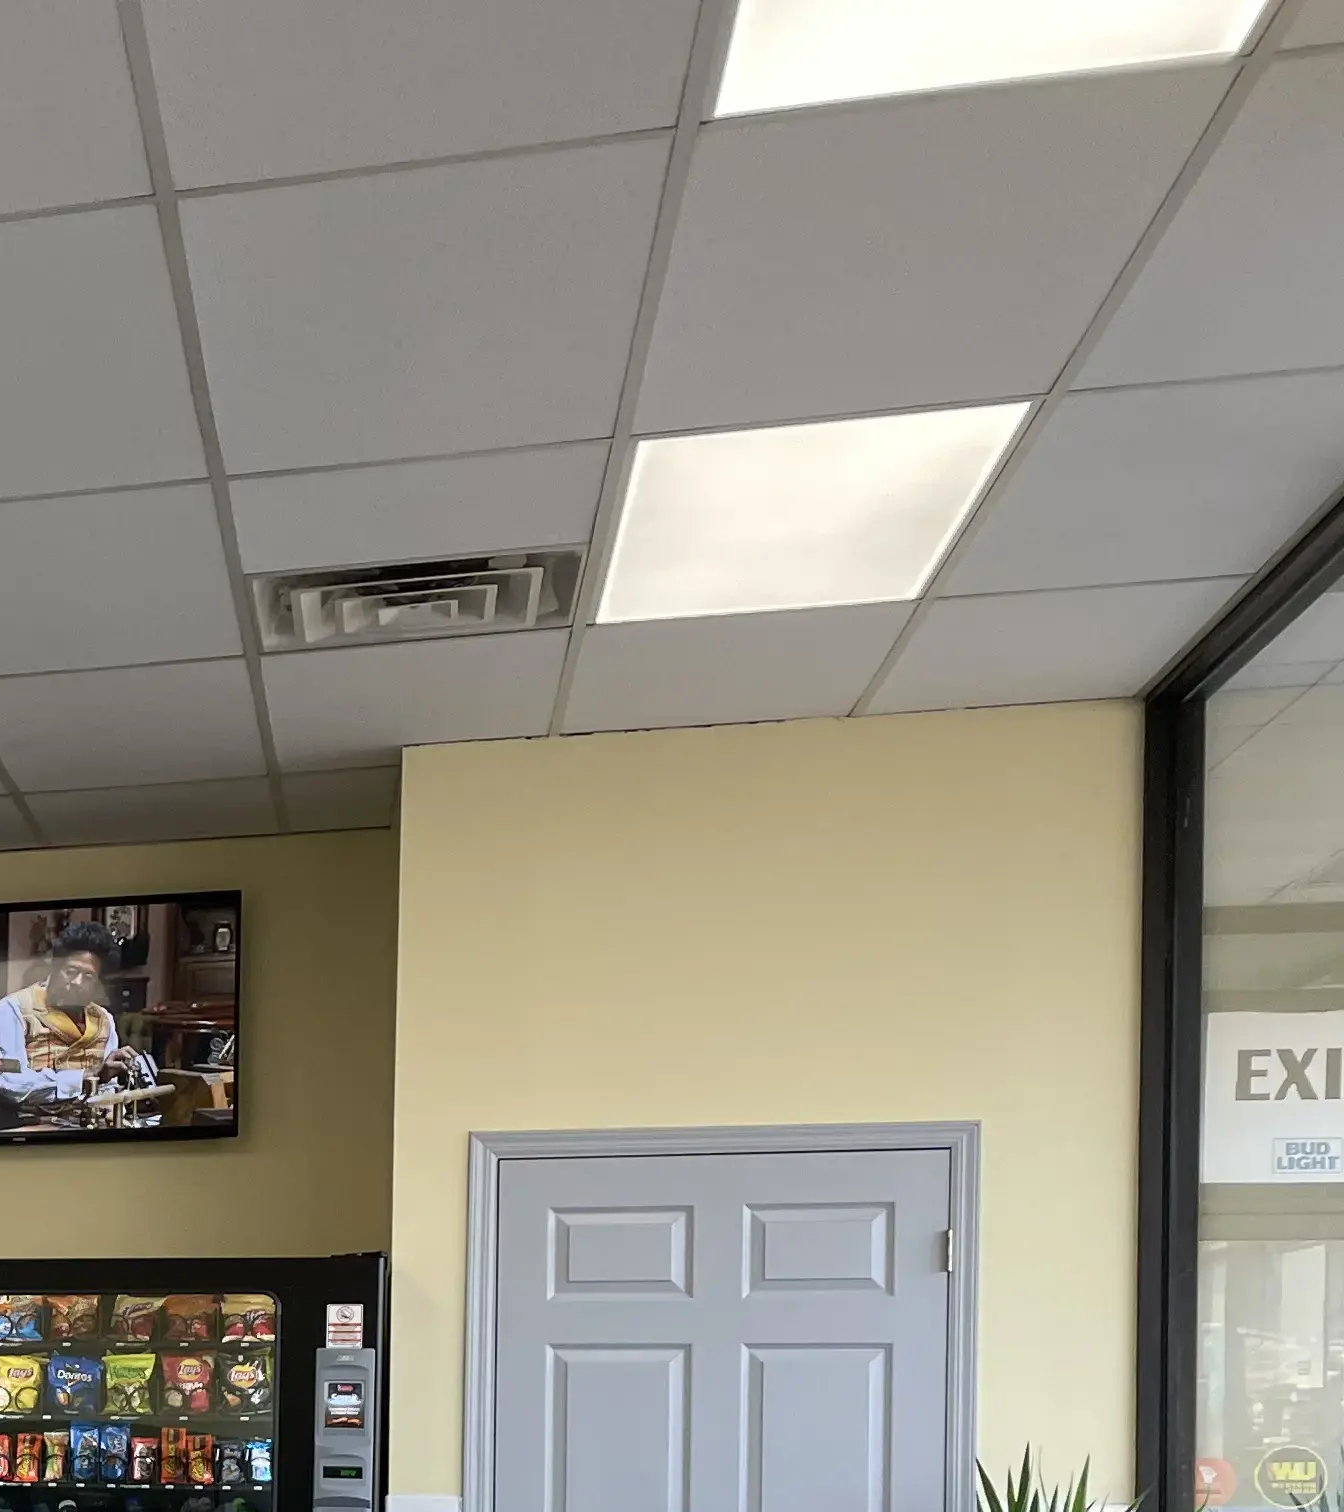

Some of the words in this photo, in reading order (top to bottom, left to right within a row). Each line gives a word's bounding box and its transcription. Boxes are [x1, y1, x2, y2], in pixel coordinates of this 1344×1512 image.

[1235, 1048, 1343, 1101] EXI
[1285, 1142, 1331, 1156] BUD
[1276, 1156, 1340, 1170] LIGHT
[57, 1370, 93, 1383] Doritos
